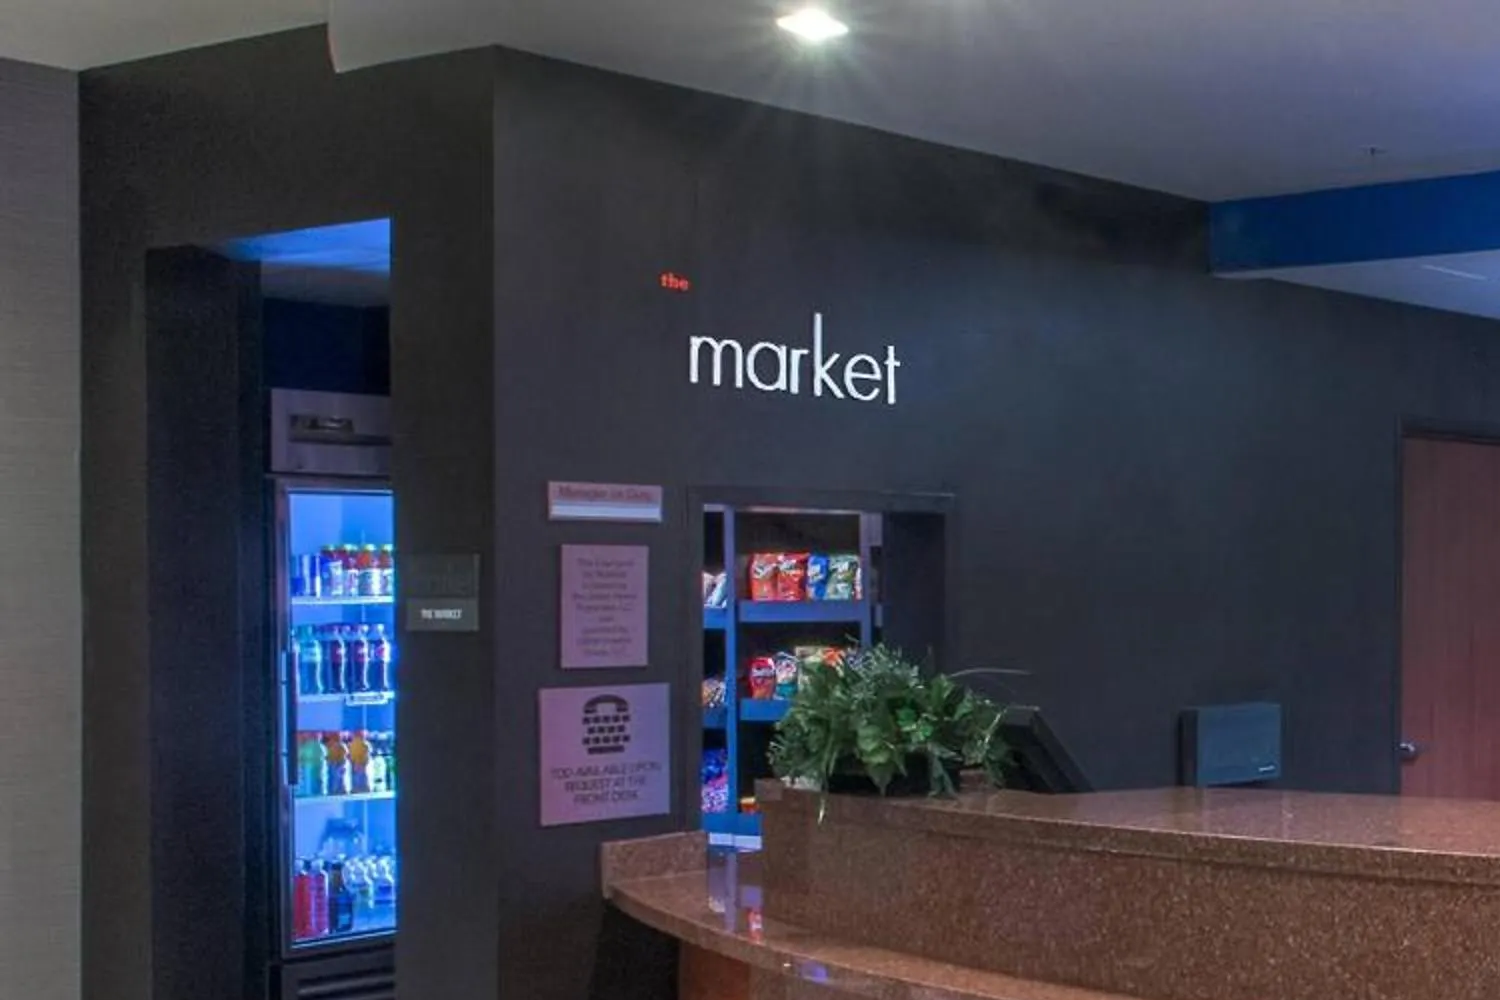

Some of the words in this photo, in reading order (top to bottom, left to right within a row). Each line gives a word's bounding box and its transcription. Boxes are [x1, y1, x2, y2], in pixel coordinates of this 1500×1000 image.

[661, 272, 689, 291] the
[689, 312, 900, 405] market
[421, 608, 433, 619] THE
[434, 608, 462, 619] MARKET
[575, 763, 627, 777] AVAILABLE
[564, 778, 609, 793] REQUEST
[611, 777, 626, 789] AT
[627, 775, 646, 788] THE
[574, 792, 609, 805] FRONT
[611, 789, 639, 802] DESK
